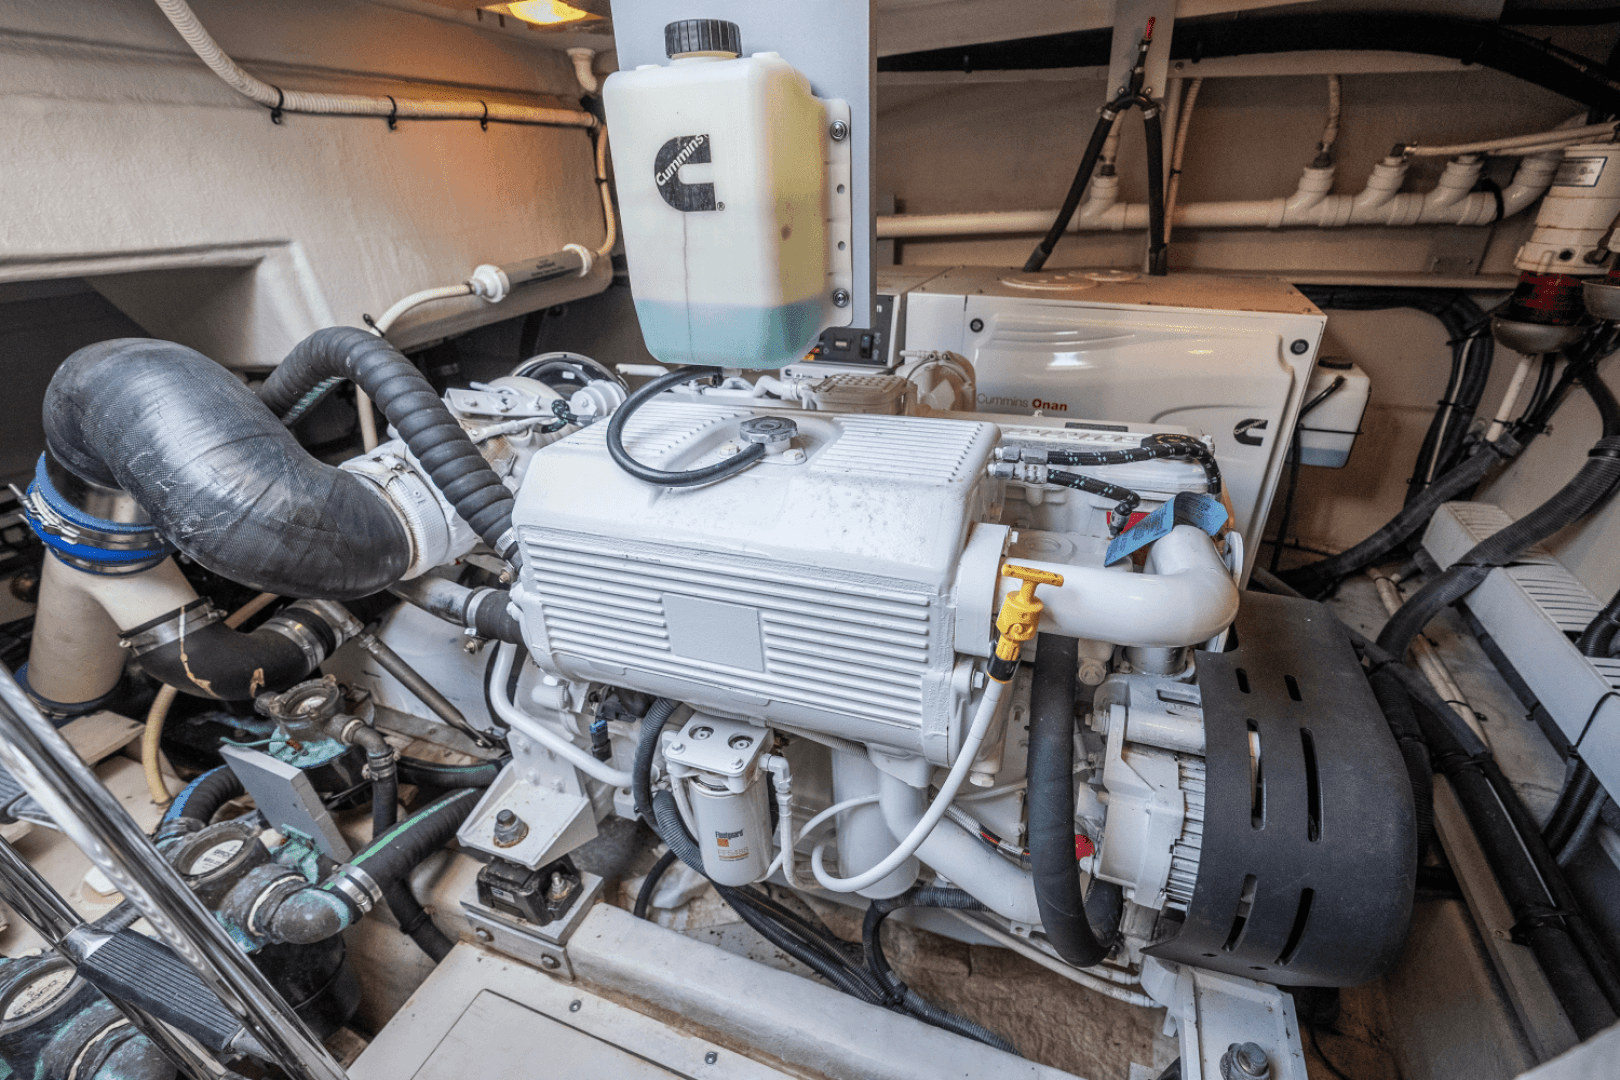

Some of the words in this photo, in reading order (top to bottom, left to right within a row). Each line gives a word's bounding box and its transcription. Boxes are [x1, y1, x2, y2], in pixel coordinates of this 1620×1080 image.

[656, 134, 704, 186] Cummins
[976, 393, 1029, 408] Cummins
[1032, 398, 1067, 412] Onan
